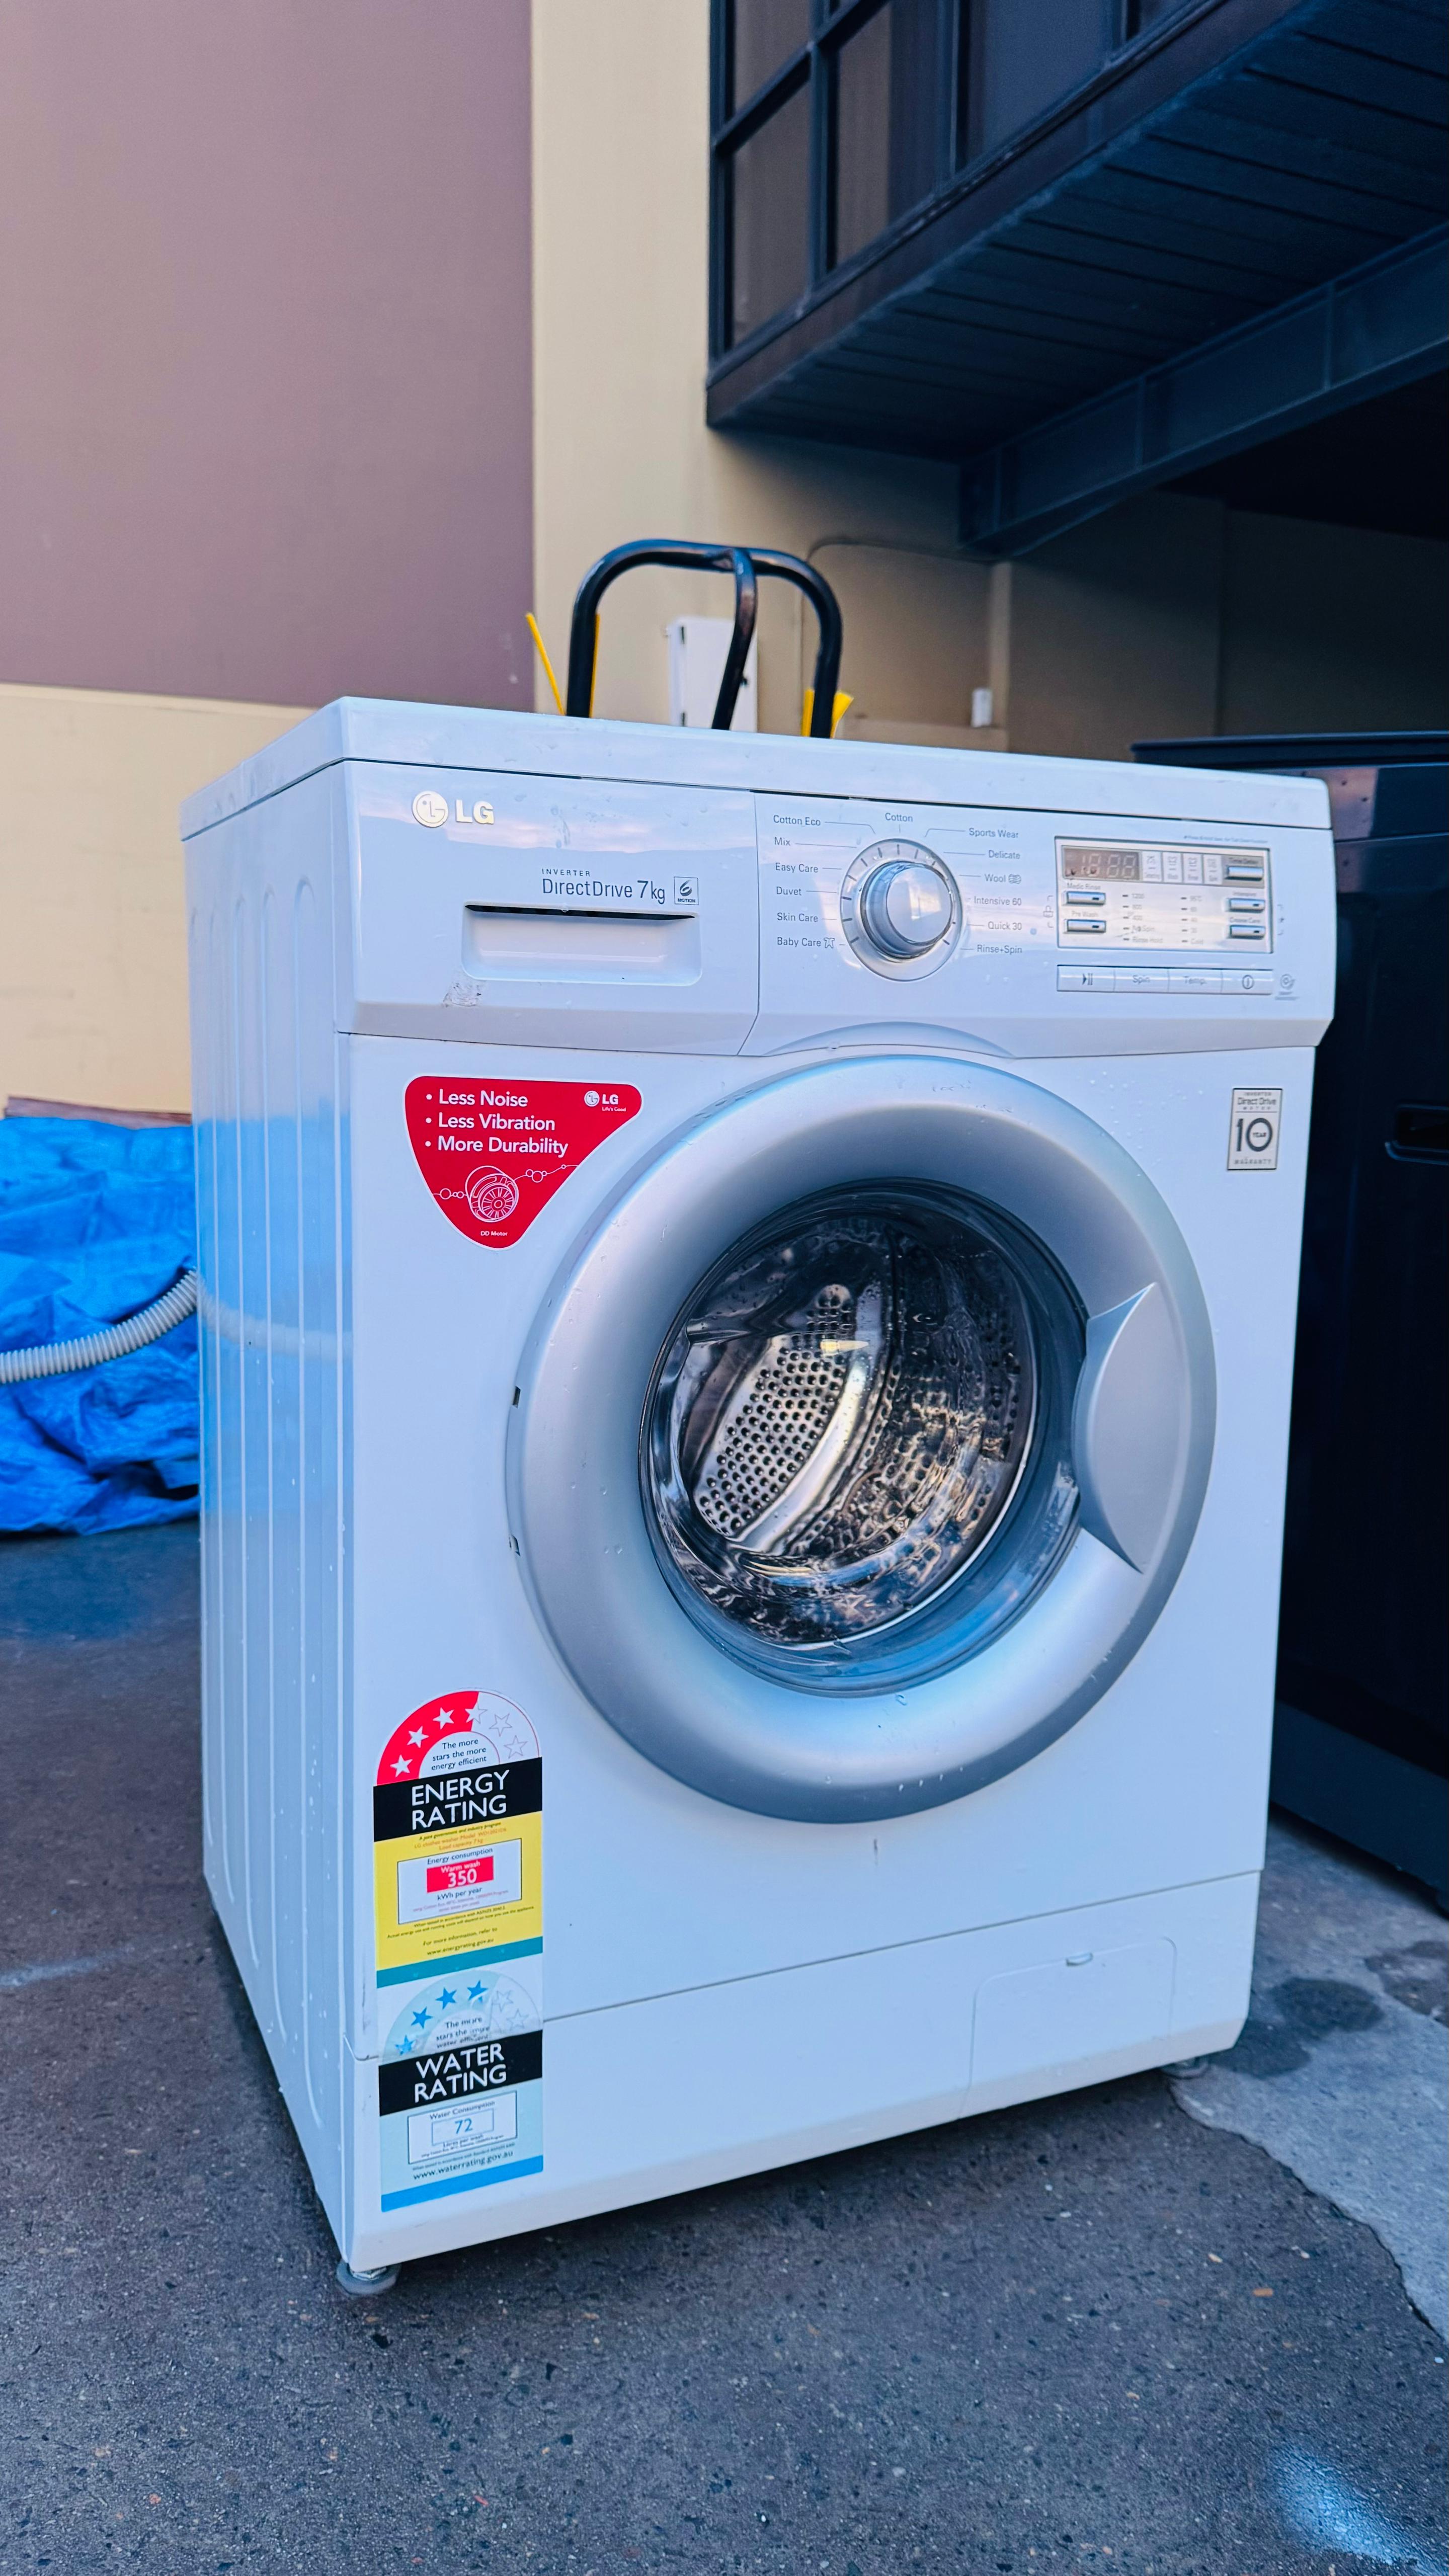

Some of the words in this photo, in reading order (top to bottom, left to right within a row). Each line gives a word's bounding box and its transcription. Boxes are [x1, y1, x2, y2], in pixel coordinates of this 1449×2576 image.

[456, 799, 495, 825] LG
[773, 815, 802, 825] Cotton
[805, 817, 821, 827] Eco
[885, 813, 913, 823] Cotton
[969, 828, 995, 839] Sports
[998, 830, 1018, 839] Wear
[774, 837, 790, 846] Mix
[988, 850, 1020, 859] Delicate
[775, 863, 795, 873] Easy
[798, 864, 819, 873] Care
[985, 874, 1006, 882] Wool
[776, 887, 801, 896] Duvet
[974, 896, 1010, 906] Intensive
[1012, 898, 1022, 906] 60
[777, 913, 796, 922] Skin
[799, 913, 818, 922] Care
[988, 922, 1010, 931] Quick
[1012, 922, 1022, 930] 30
[777, 937, 799, 948] Baby
[802, 938, 821, 947] Care
[977, 945, 1022, 955] Rinse+Spin
[1133, 975, 1151, 984] Spin
[439, 1089, 475, 1105] Less
[480, 1091, 528, 1107] Noise
[602, 1094, 618, 1104] LG
[439, 1112, 474, 1128] Less
[479, 1114, 555, 1131] Vibration
[1236, 1118, 1273, 1152] 10
[438, 1136, 484, 1152] More
[489, 1137, 568, 1158] Durability
[459, 1739, 478, 1747] more
[467, 1747, 486, 1755] more
[431, 1762, 456, 1771] energy
[458, 1756, 487, 1766] efficient
[412, 1769, 509, 1806] ENERGY
[412, 1795, 506, 1830] RATING
[427, 1857, 449, 1865] Energy
[451, 1847, 493, 1860] consumption
[463, 1860, 480, 1869] wash
[448, 1868, 477, 1888] 350
[468, 1888, 482, 1896] year
[416, 2043, 505, 2078] WATER
[414, 2064, 506, 2103] RATING
[430, 2111, 451, 2120] Water
[452, 2101, 495, 2115] Consumption
[455, 2118, 473, 2134] 72
[413, 2151, 514, 2181] www.waterrating.gov.au
